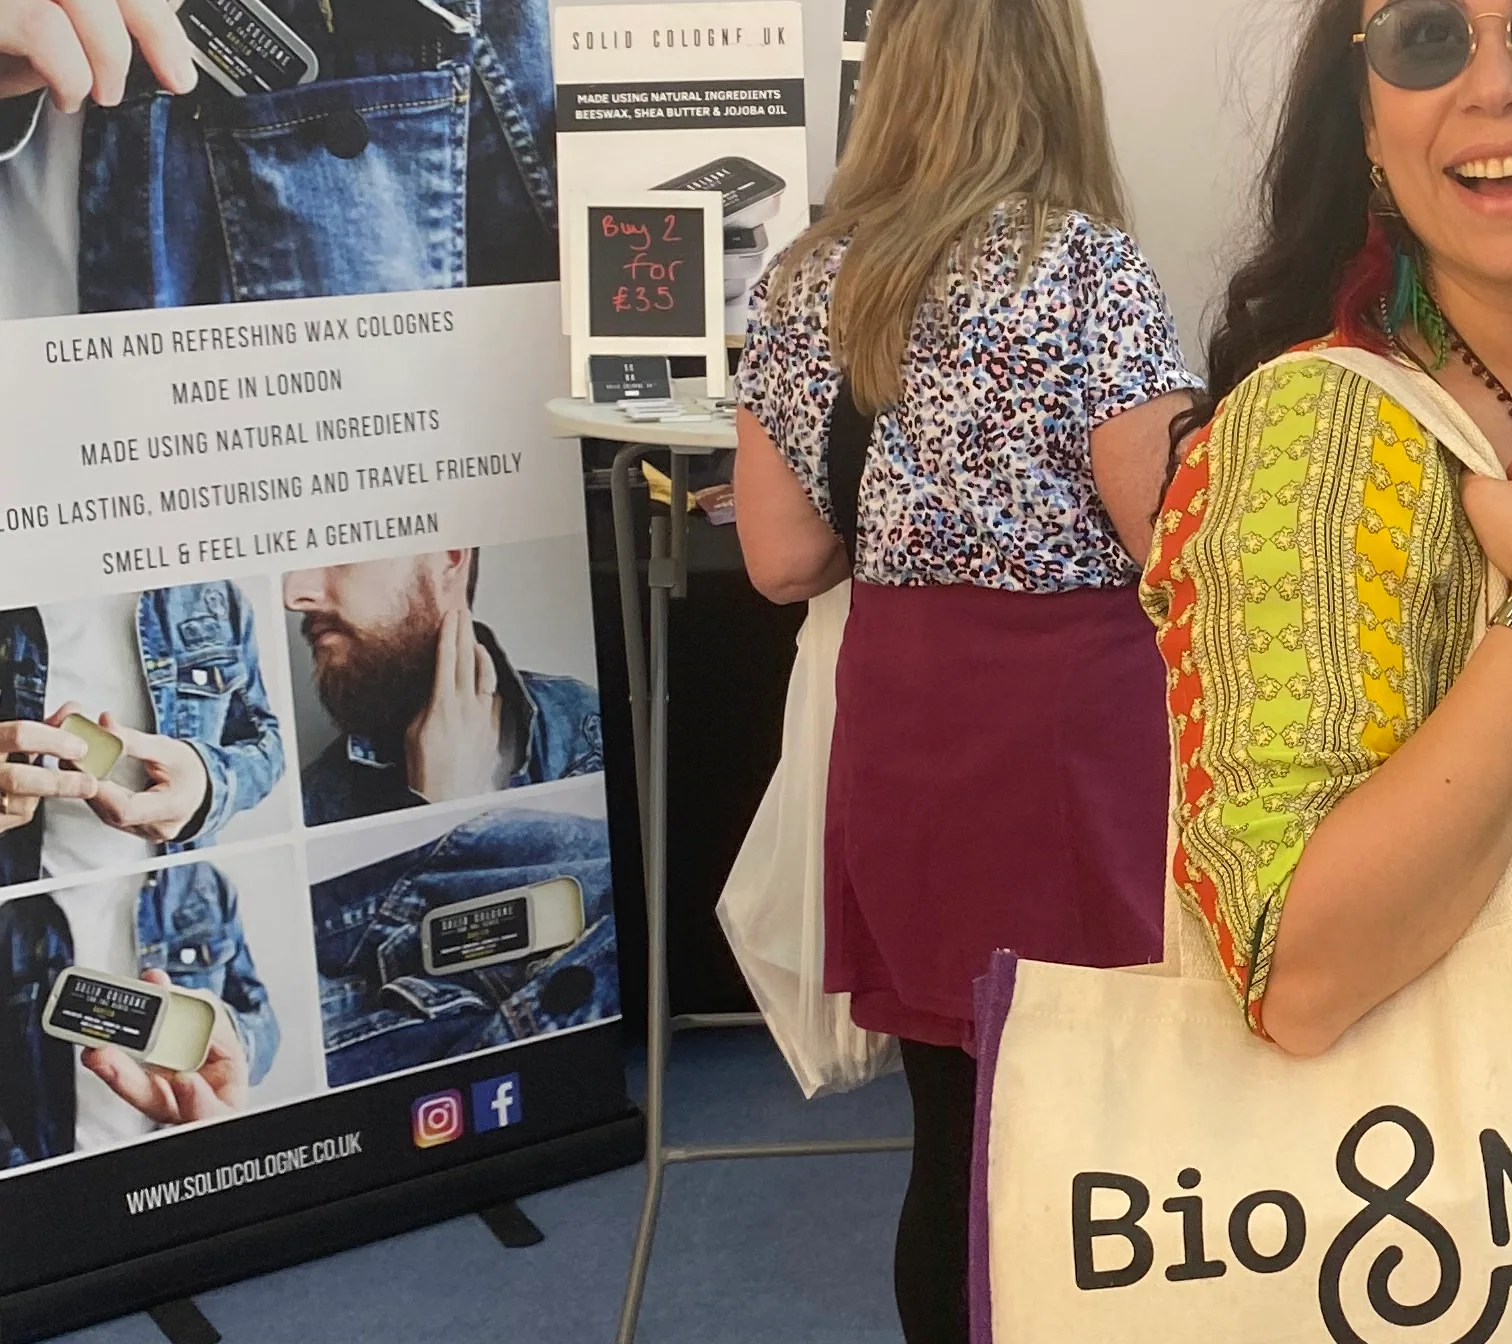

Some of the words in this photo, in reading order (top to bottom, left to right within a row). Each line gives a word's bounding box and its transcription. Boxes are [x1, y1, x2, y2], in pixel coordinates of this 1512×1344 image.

[572, 30, 633, 50] SOLID
[763, 26, 786, 46] UK
[575, 108, 632, 120] BEESWAX,
[634, 107, 665, 118] SHEA
[666, 106, 710, 118] BUTTER
[712, 106, 721, 117] &
[723, 105, 765, 117] JOJOBA
[767, 104, 787, 116] OIL
[577, 93, 609, 105] MADE
[611, 92, 649, 104] USING
[651, 91, 702, 103] NATURAL
[704, 89, 781, 101] INGREDIENTS
[601, 213, 651, 252] Buy
[661, 214, 683, 242] 2
[45, 336, 115, 365] CLEAN
[121, 331, 165, 357] AND
[171, 321, 298, 355] REFRESHING
[304, 317, 351, 344] WAX
[356, 310, 455, 339] COLOGNES
[171, 378, 230, 406] MADE
[237, 376, 258, 400] IN
[264, 368, 344, 397] LONDON
[80, 437, 140, 467] MADE
[147, 431, 209, 460] USING
[215, 422, 310, 453] NATURAL
[315, 409, 441, 442] INGREDIENTS
[57, 494, 153, 526] LASTING,
[160, 476, 302, 514] MOISTURISING
[310, 469, 350, 496] AND
[355, 462, 430, 490] TRAVEL
[435, 451, 523, 483] FRIENDLY
[101, 543, 170, 575] SMELL
[178, 542, 191, 565] &
[198, 537, 246, 563] FEEL
[254, 531, 299, 556] LIKE
[305, 527, 319, 549] A
[325, 512, 440, 546] GENTLEMAN
[125, 1132, 363, 1216] WWW.SOLIDCOLOGNE.CO.UK
[1071, 1167, 1306, 1291] Bio
